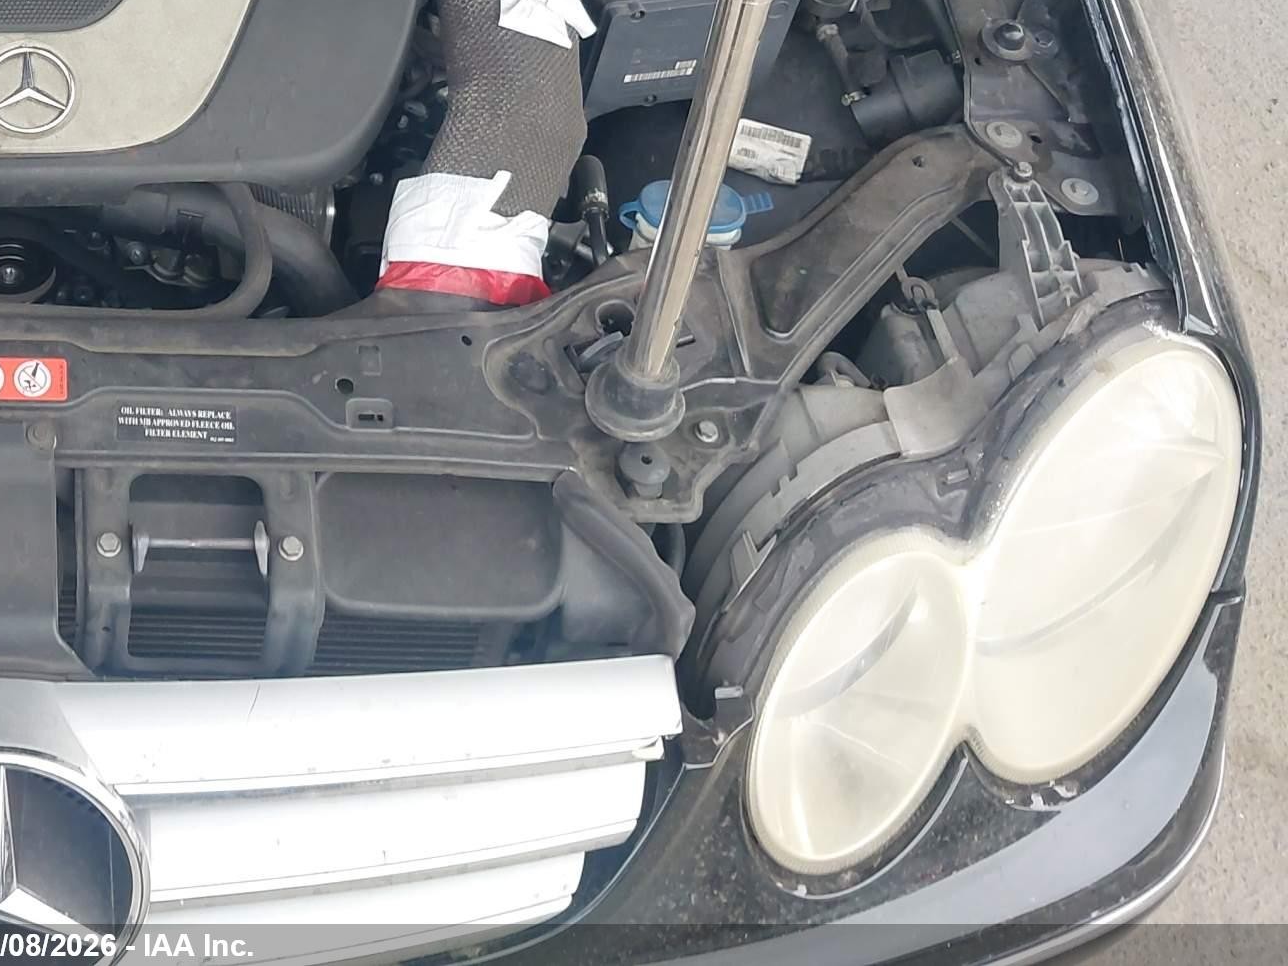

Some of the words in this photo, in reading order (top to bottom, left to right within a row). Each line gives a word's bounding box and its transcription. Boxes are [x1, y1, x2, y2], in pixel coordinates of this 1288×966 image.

[120, 406, 134, 415] OIL
[168, 408, 197, 418] ALWAYS
[197, 410, 232, 420] REPLACE
[118, 417, 139, 426] WITH
[139, 417, 151, 427] MB
[152, 418, 191, 428] APPROVED
[191, 420, 220, 430] FLEECE
[220, 422, 235, 431] OIL
[144, 428, 171, 437] FILTER
[172, 429, 208, 440] ELEMENT
